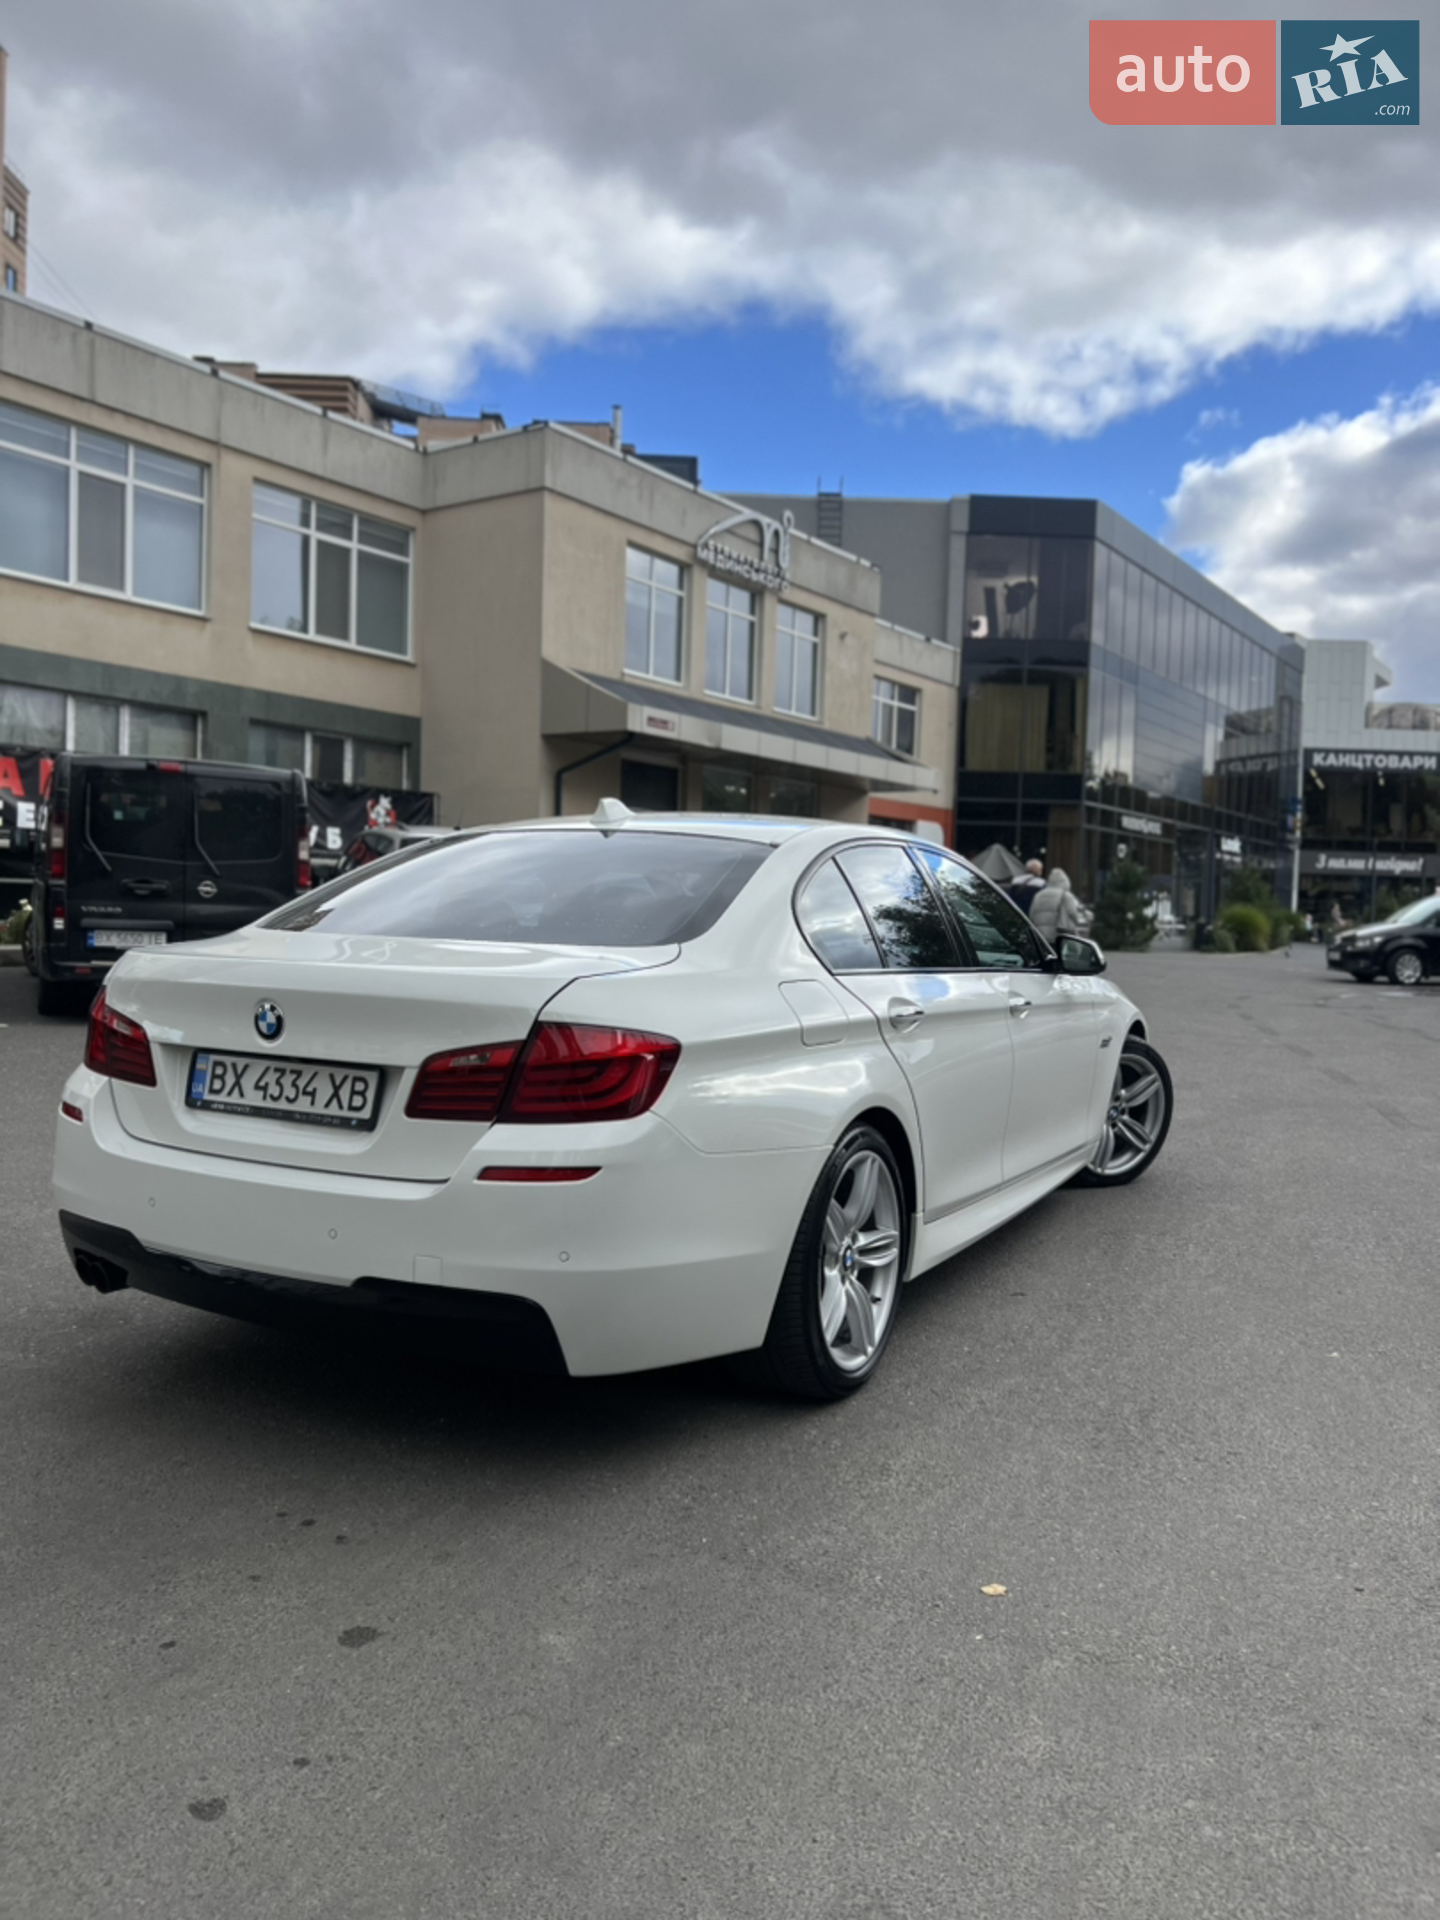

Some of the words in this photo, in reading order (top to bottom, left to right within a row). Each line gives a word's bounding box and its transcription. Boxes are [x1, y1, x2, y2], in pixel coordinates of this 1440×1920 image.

[1312, 752, 1437, 770] КАНЦТОВАРИ
[208, 1060, 250, 1099] BX
[253, 1065, 319, 1107] 4334
[323, 1072, 369, 1112] XB
